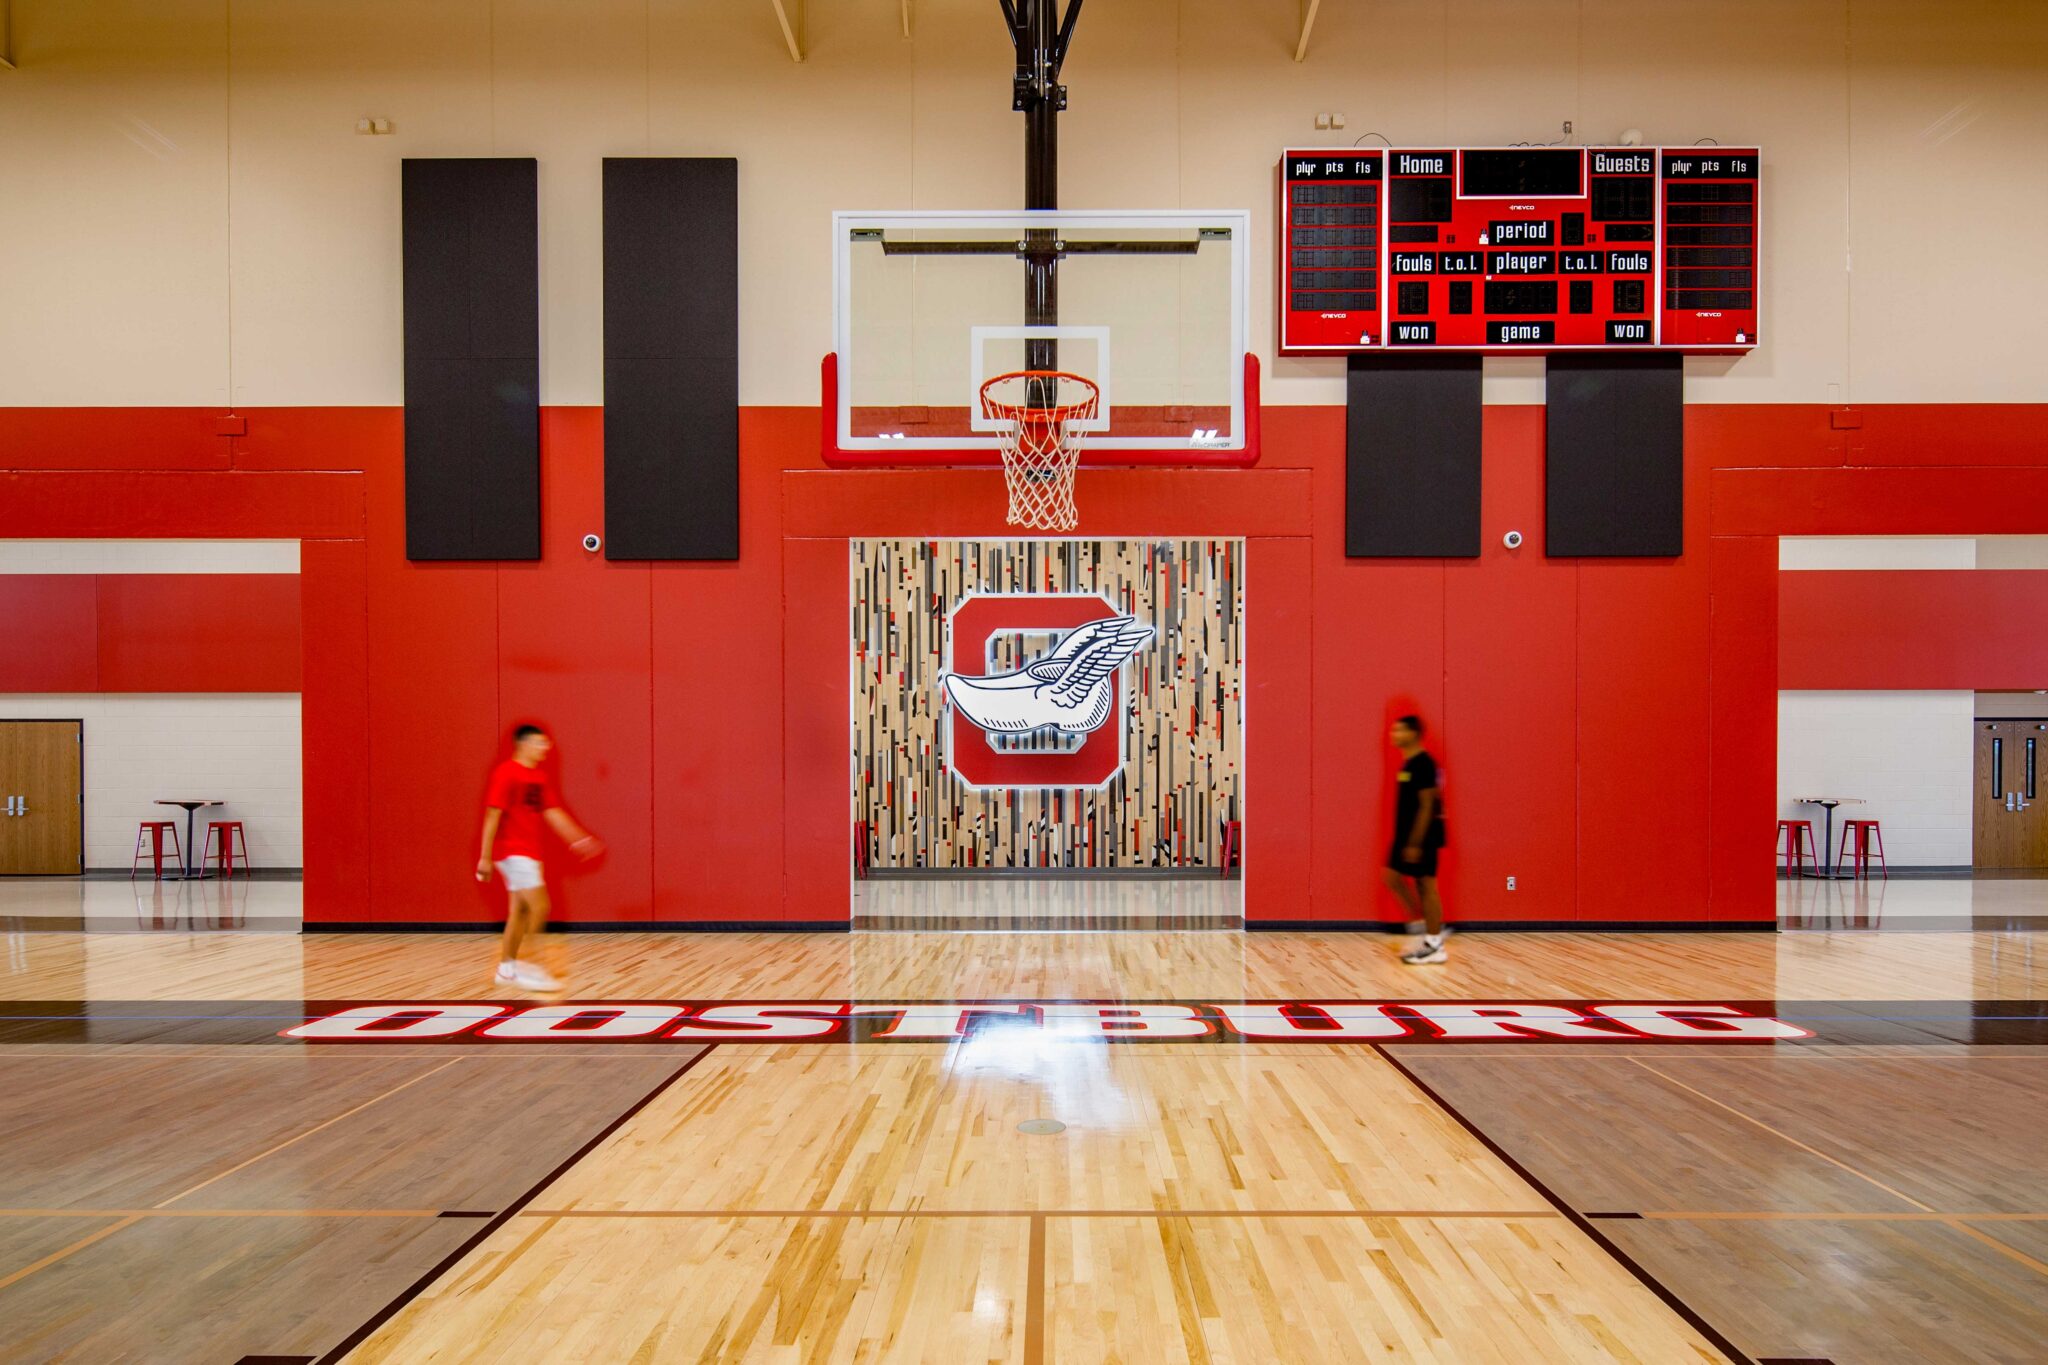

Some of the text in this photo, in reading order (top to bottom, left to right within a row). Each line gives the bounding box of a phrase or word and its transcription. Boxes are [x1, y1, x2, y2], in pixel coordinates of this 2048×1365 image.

[1296, 162, 1371, 176] plyr pts fls
[1400, 156, 1443, 174] Home
[1595, 154, 1650, 173] Guests
[1671, 161, 1747, 175] plyr pts fls
[1496, 222, 1547, 243] period
[1396, 255, 1432, 272] fouls
[1444, 255, 1477, 271] t.o.l.
[1496, 253, 1547, 274] player
[1565, 255, 1598, 270] t.o.l.
[1611, 254, 1648, 271] fouls
[1398, 327, 1429, 340] won
[1501, 327, 1540, 343] game
[1614, 325, 1644, 338] won
[277, 1003, 1816, 1039] OOSTBURG
